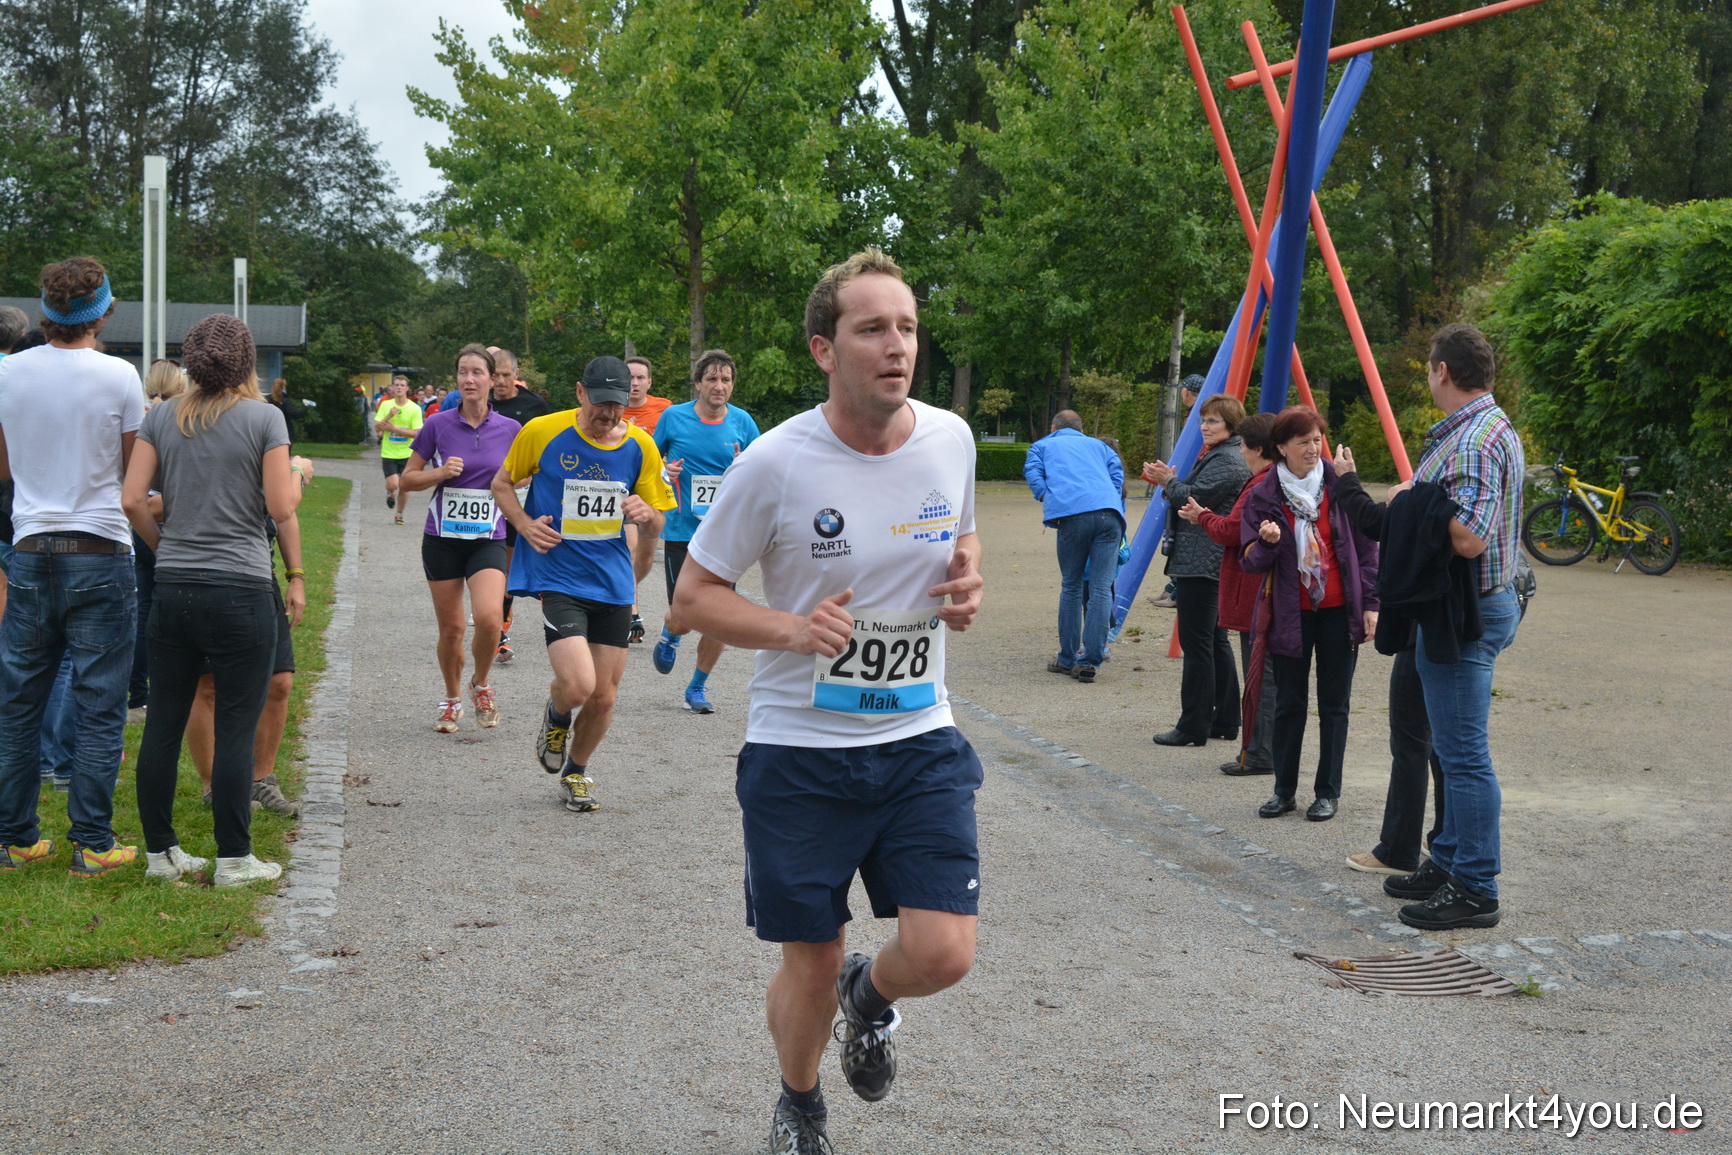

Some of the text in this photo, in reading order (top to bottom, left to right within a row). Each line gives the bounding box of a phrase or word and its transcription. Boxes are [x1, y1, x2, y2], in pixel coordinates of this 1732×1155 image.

[589, 485, 619, 493] Neumarkt
[447, 500, 490, 520] 2499
[577, 495, 615, 518] 644
[455, 524, 480, 532] Kathrin
[890, 523, 911, 536] 14.
[907, 519, 940, 528] Neumarkter
[36, 540, 78, 552] PMA
[811, 539, 851, 552] PARTL
[812, 549, 851, 559] Neumarkt
[872, 620, 926, 633] Neumarkt
[830, 636, 930, 681] 2928
[859, 693, 900, 710] Maik
